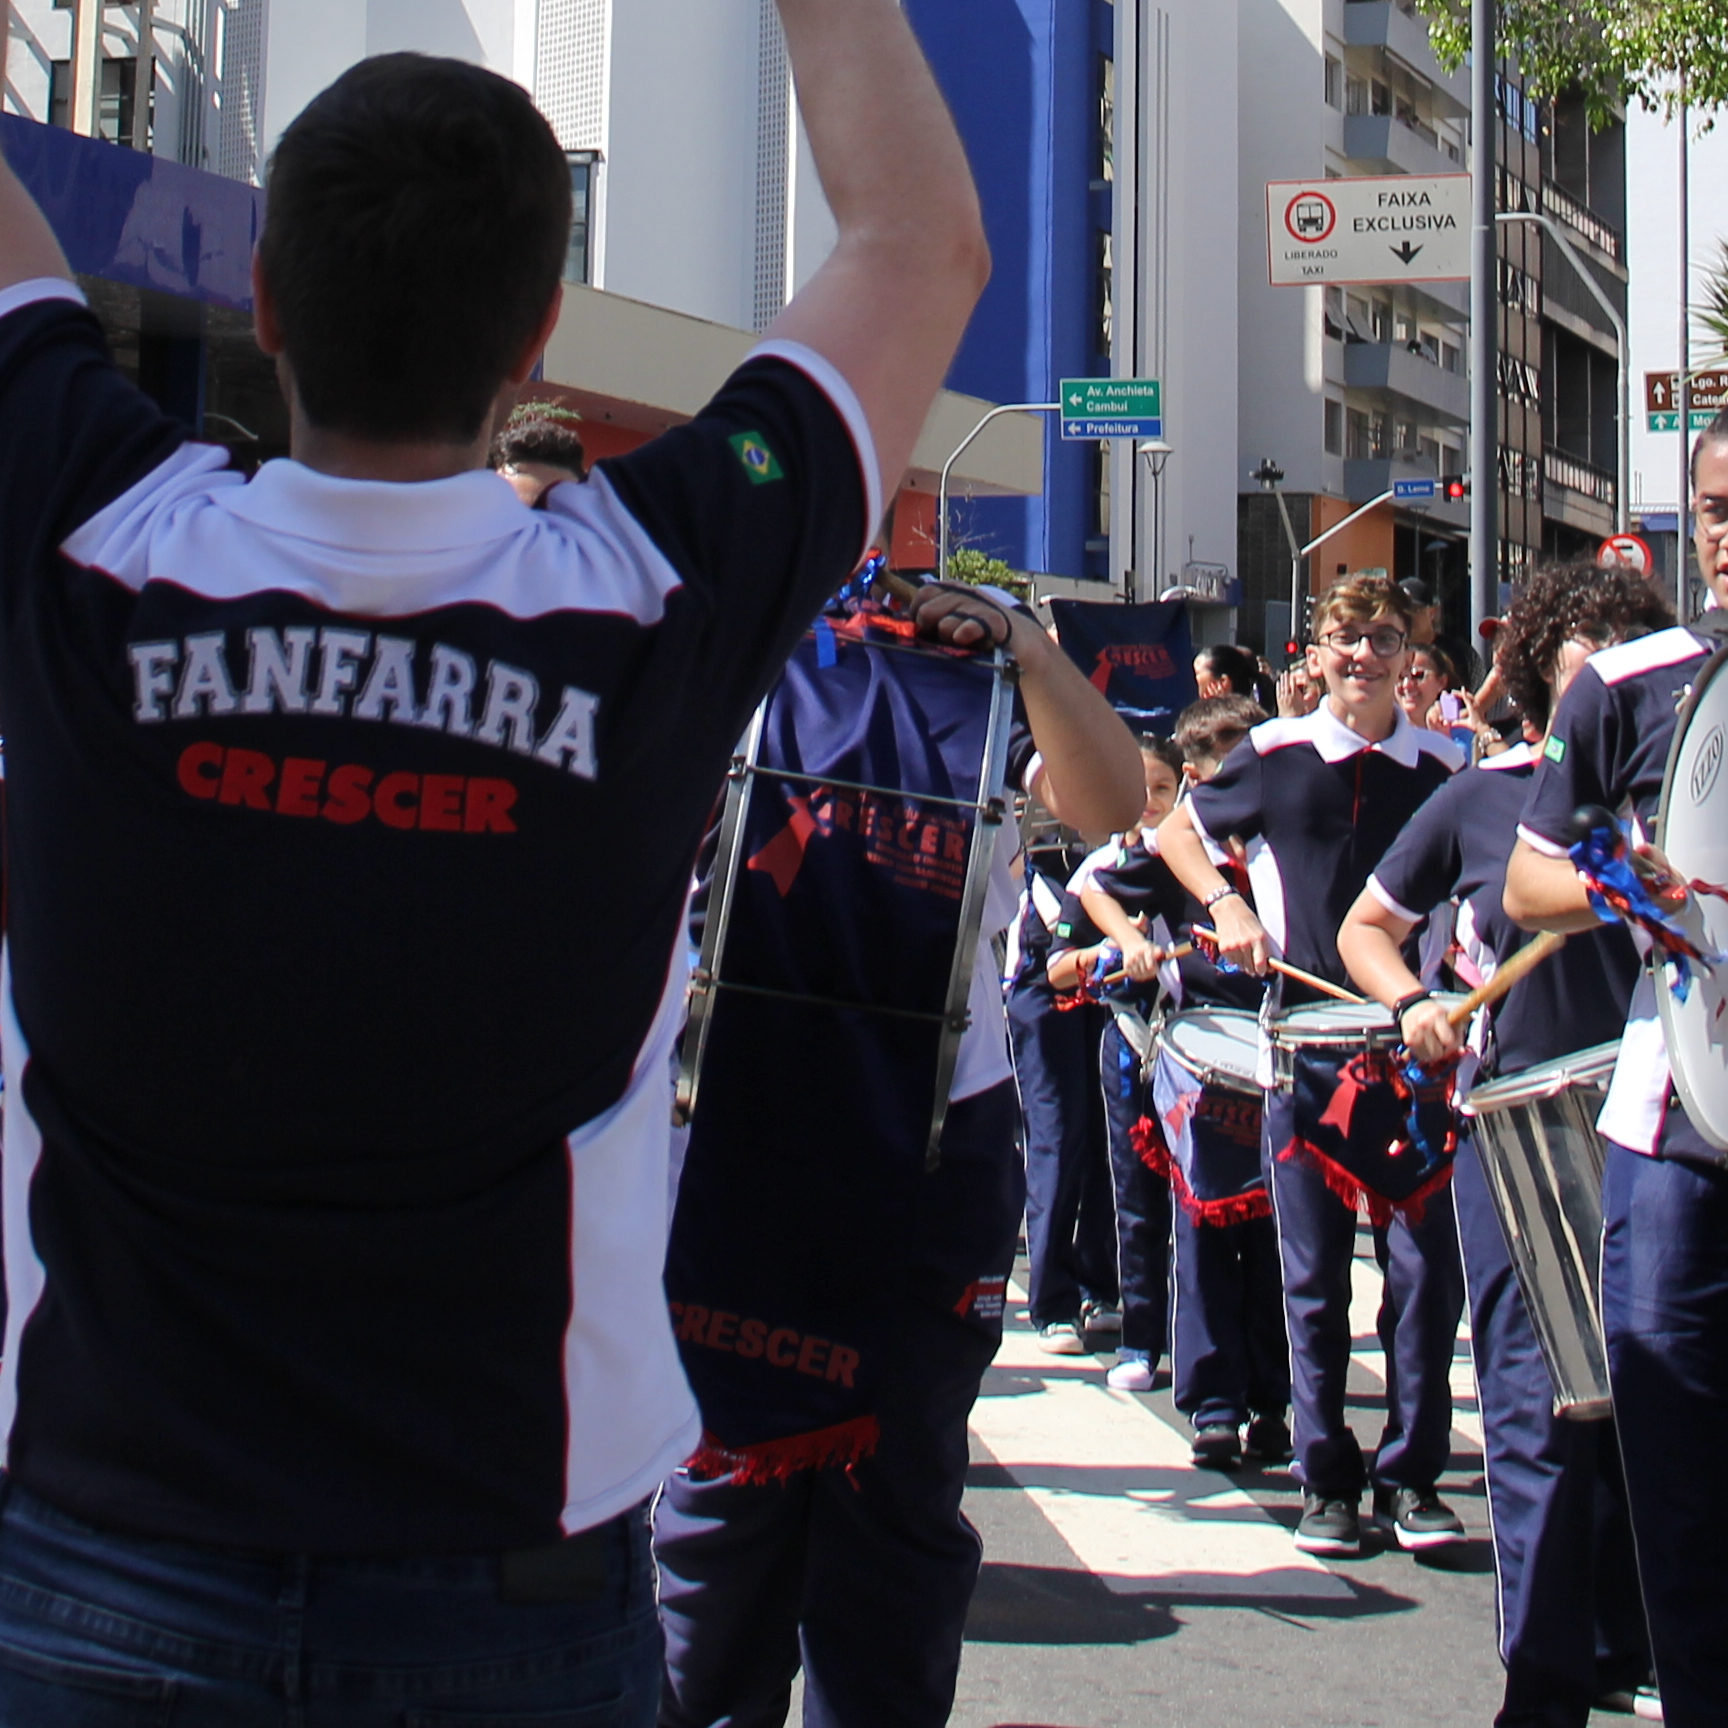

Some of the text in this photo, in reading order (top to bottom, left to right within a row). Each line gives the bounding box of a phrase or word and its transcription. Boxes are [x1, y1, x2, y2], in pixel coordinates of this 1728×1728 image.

[1378, 191, 1431, 208] FAIXA
[1353, 215, 1457, 233] EXCLUSIVA
[1285, 249, 1338, 261] LIBERADO
[1301, 266, 1325, 276] TAXI
[1086, 384, 1155, 397] Av. Anchieta
[1691, 374, 1717, 391] Lgo.
[1086, 422, 1140, 435] Prefeitura
[128, 626, 600, 781] FANFARRA
[177, 742, 519, 834] CRESCER
